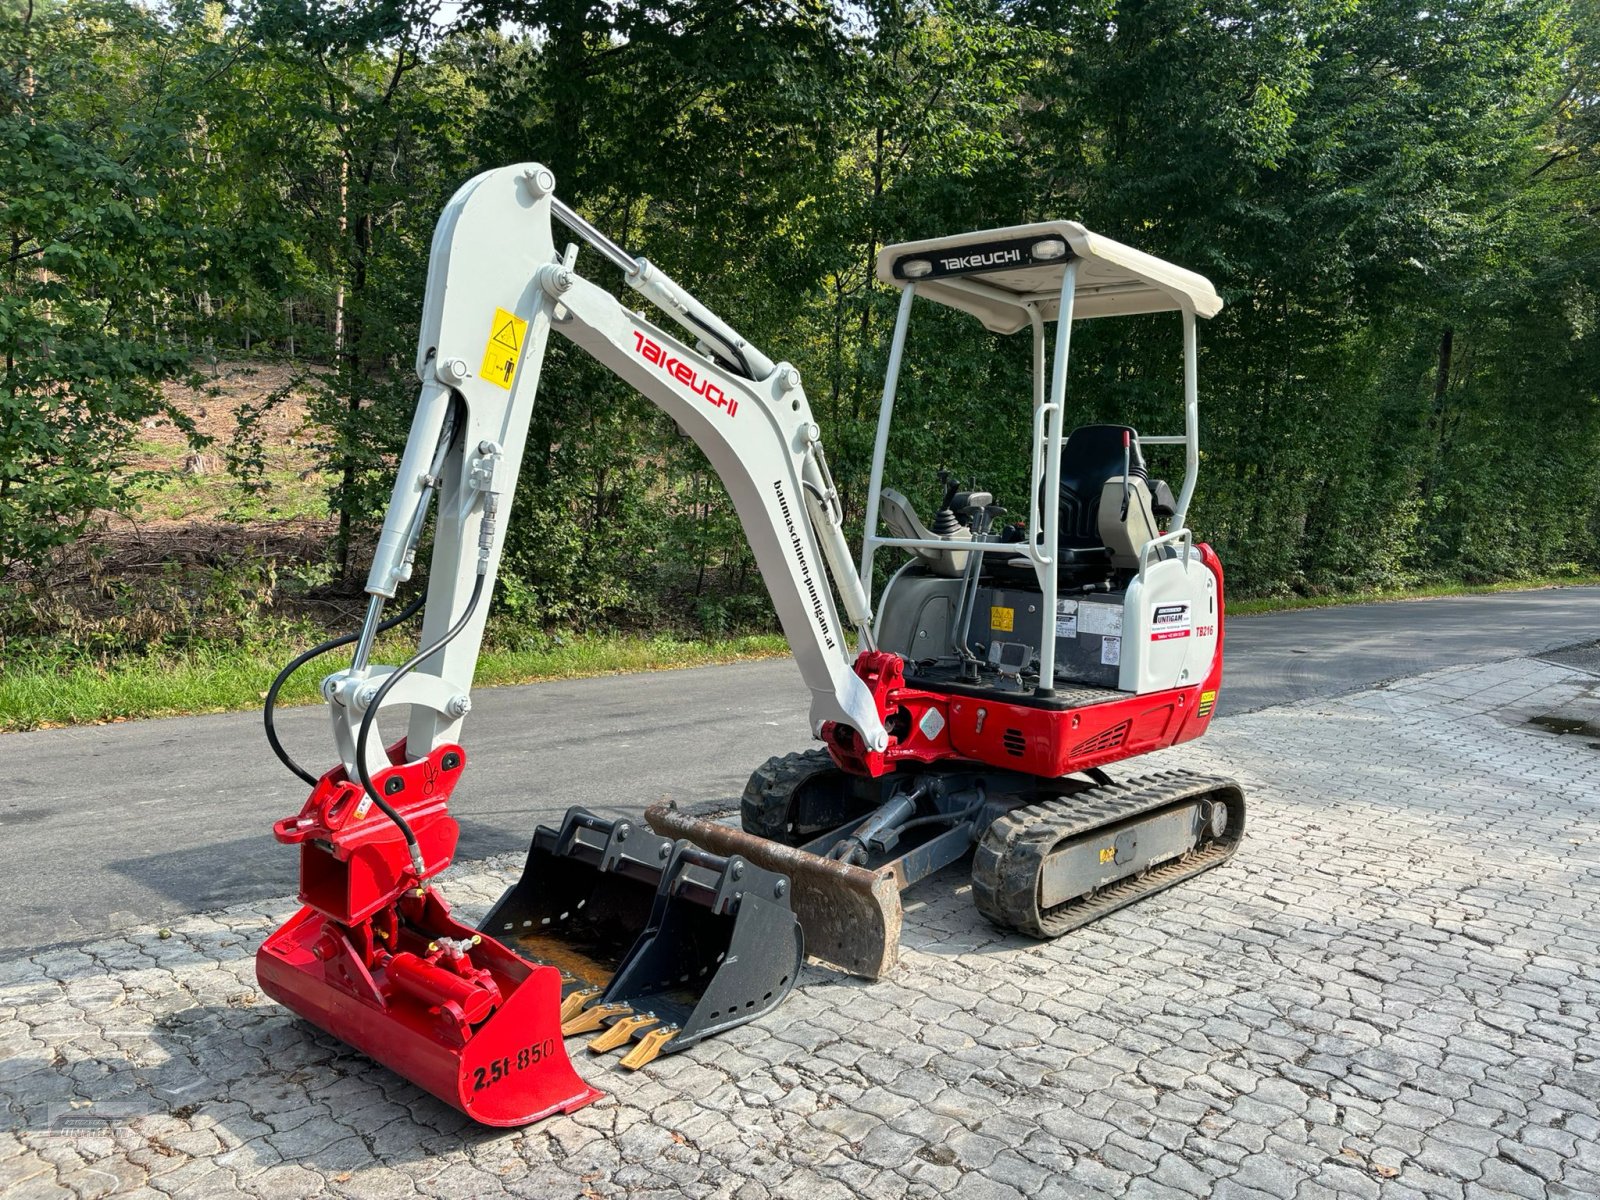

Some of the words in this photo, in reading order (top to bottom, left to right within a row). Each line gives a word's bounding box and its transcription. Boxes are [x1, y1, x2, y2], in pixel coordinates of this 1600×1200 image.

[940, 249, 1021, 271] TAKEUCHI
[633, 330, 739, 418] TAKEUCHI
[773, 480, 836, 651] baumaschinen-puntigam.at
[1196, 625, 1214, 638] TB216
